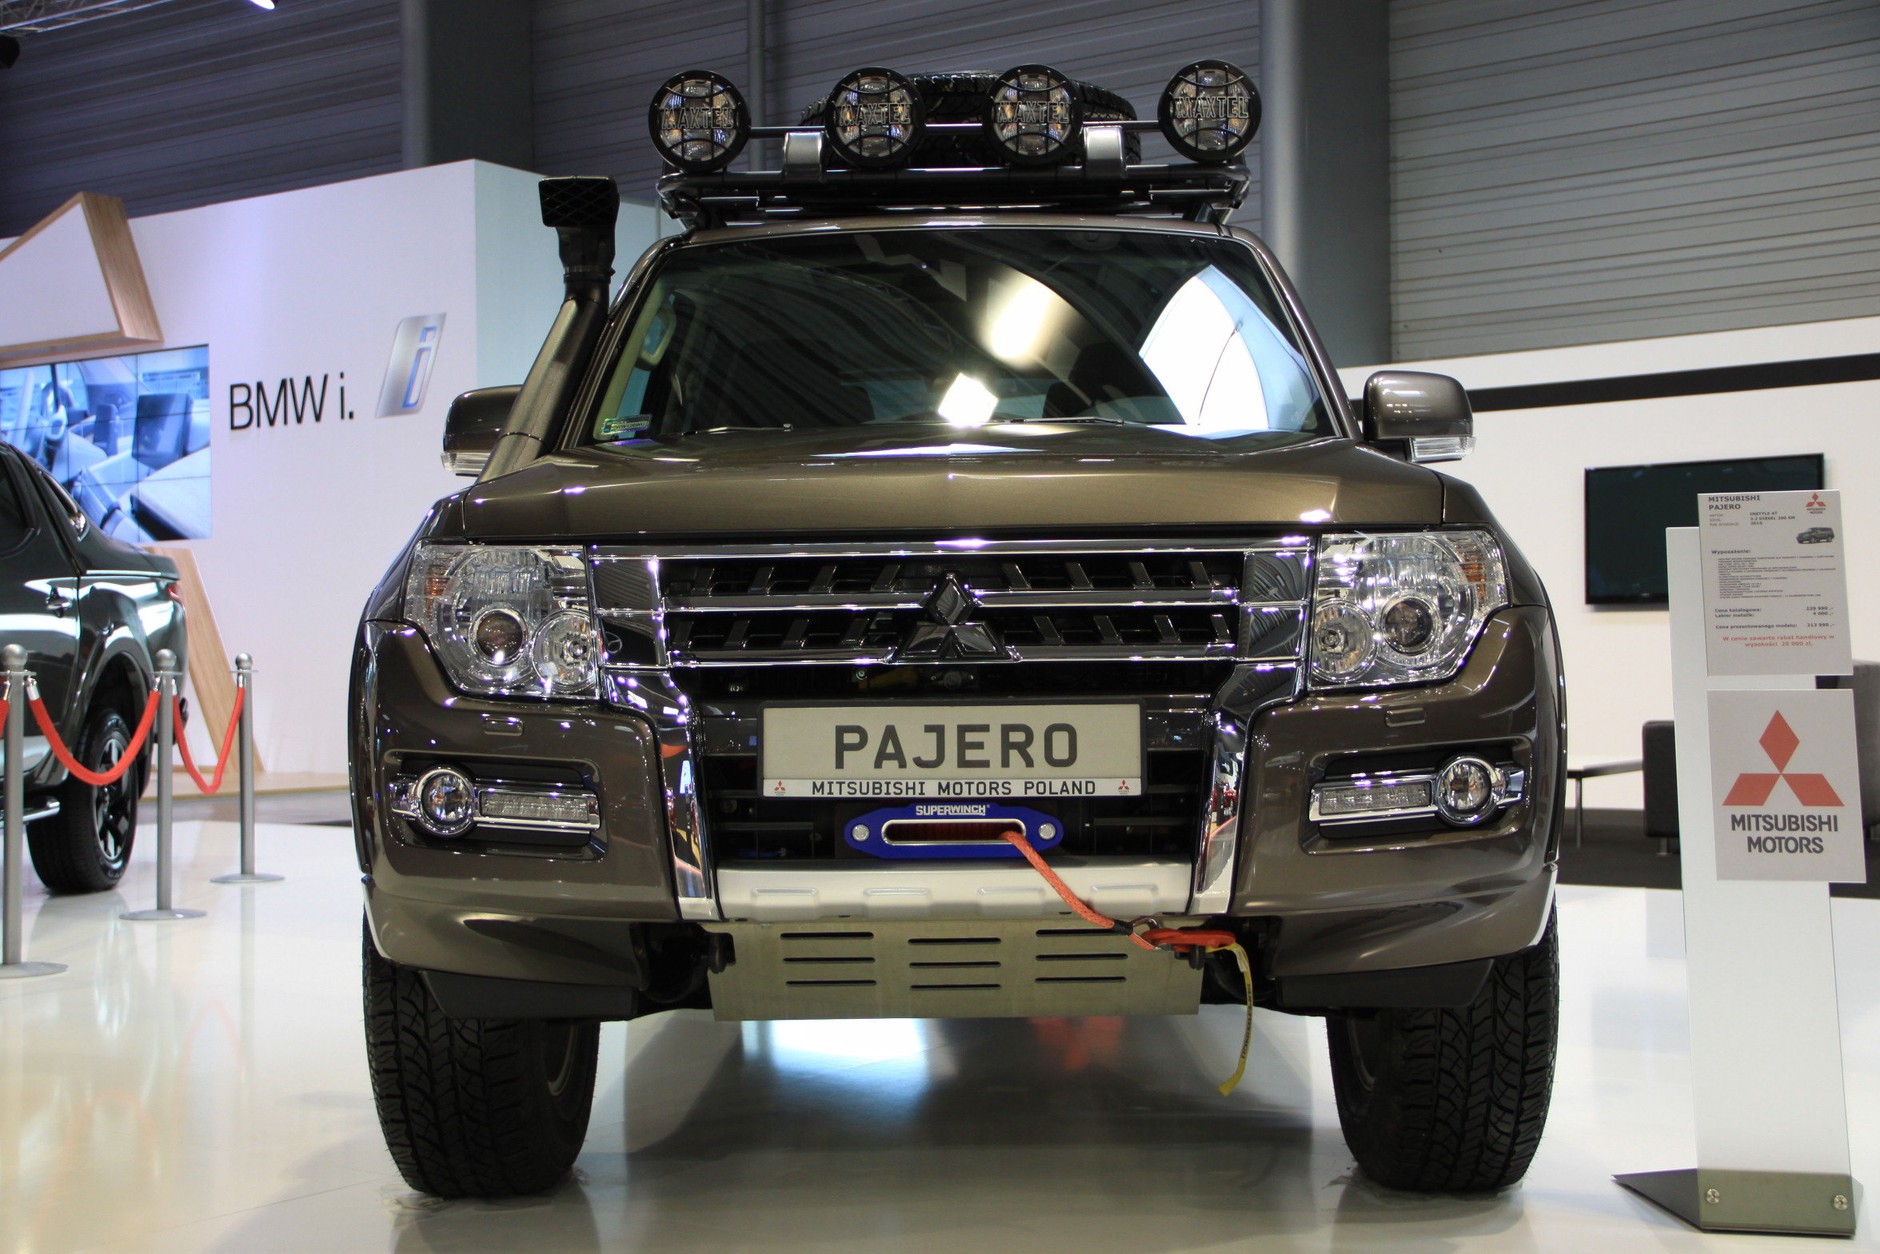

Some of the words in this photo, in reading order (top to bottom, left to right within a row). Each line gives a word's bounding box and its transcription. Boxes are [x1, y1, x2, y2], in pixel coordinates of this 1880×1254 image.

[661, 107, 736, 130] MAXTEL
[838, 103, 912, 127] MAXTEL
[997, 100, 1070, 124] MAXTEL
[1176, 97, 1250, 119] MAXTEL
[229, 373, 329, 431] BMW
[339, 371, 354, 420] i.
[834, 722, 1077, 769] PAJERO
[812, 781, 926, 796] MITSUBISHI
[937, 781, 1012, 796] MOTORS
[1024, 781, 1096, 796] POLAND
[915, 804, 986, 816] SUPERWINCH
[1731, 814, 1838, 832] MITSUBISHI
[1747, 836, 1824, 854] MOTORS
